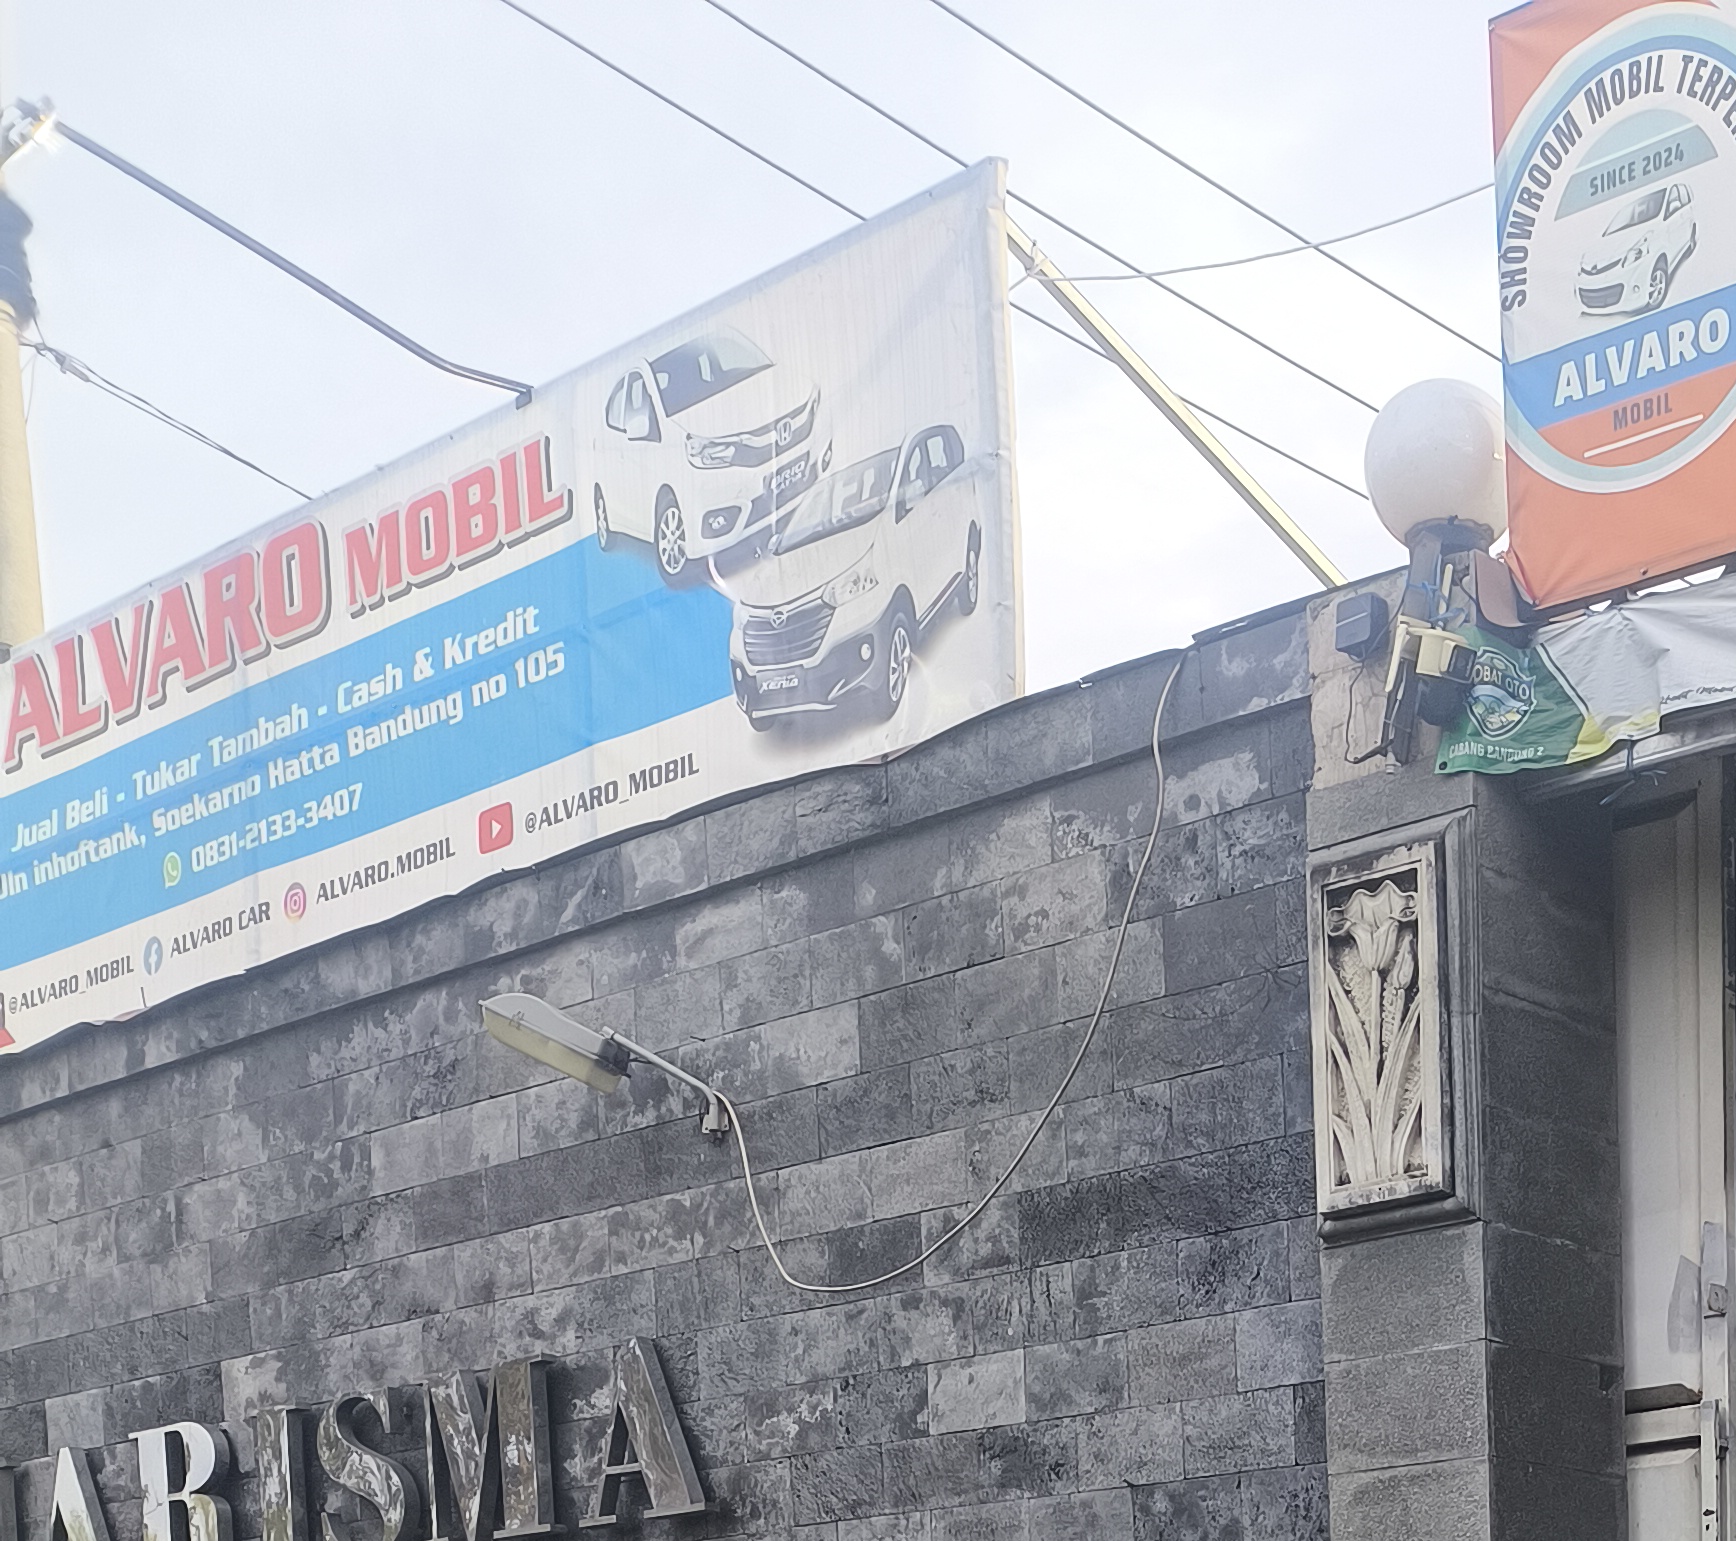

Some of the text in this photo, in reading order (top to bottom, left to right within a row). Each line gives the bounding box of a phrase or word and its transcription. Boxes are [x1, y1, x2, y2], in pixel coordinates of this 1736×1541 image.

[1501, 110, 1584, 312] SHOWROOM
[1582, 54, 1665, 124] MOBIL
[1589, 142, 1685, 197] SINCE 2024
[1553, 308, 1731, 408] ALVARO
[1613, 393, 1673, 431] MOBIL
[2, 438, 572, 774] ALVARO MOBIL
[1472, 664, 1502, 685] OBAT
[11, 810, 58, 852] Jual
[66, 786, 109, 829] Beli
[132, 752, 201, 800] Tukar
[208, 703, 309, 767] Tambah
[337, 662, 403, 714] Cash
[413, 646, 435, 682] &
[443, 605, 540, 669] Kredit
[34, 822, 146, 886] inhoftank,
[152, 774, 261, 837] Soekarno
[268, 742, 340, 789] Hatta
[347, 691, 463, 757] Bandung
[472, 674, 507, 706] no
[515, 641, 565, 689] 105
[1449, 741, 1484, 758] CABANG
[190, 781, 363, 873] 0831-2133-3407
[9, 753, 700, 1014] @ALVARO_MOBIL ALVARO CAR ALVARO.MOBIL @ALVARO_MOBIL
